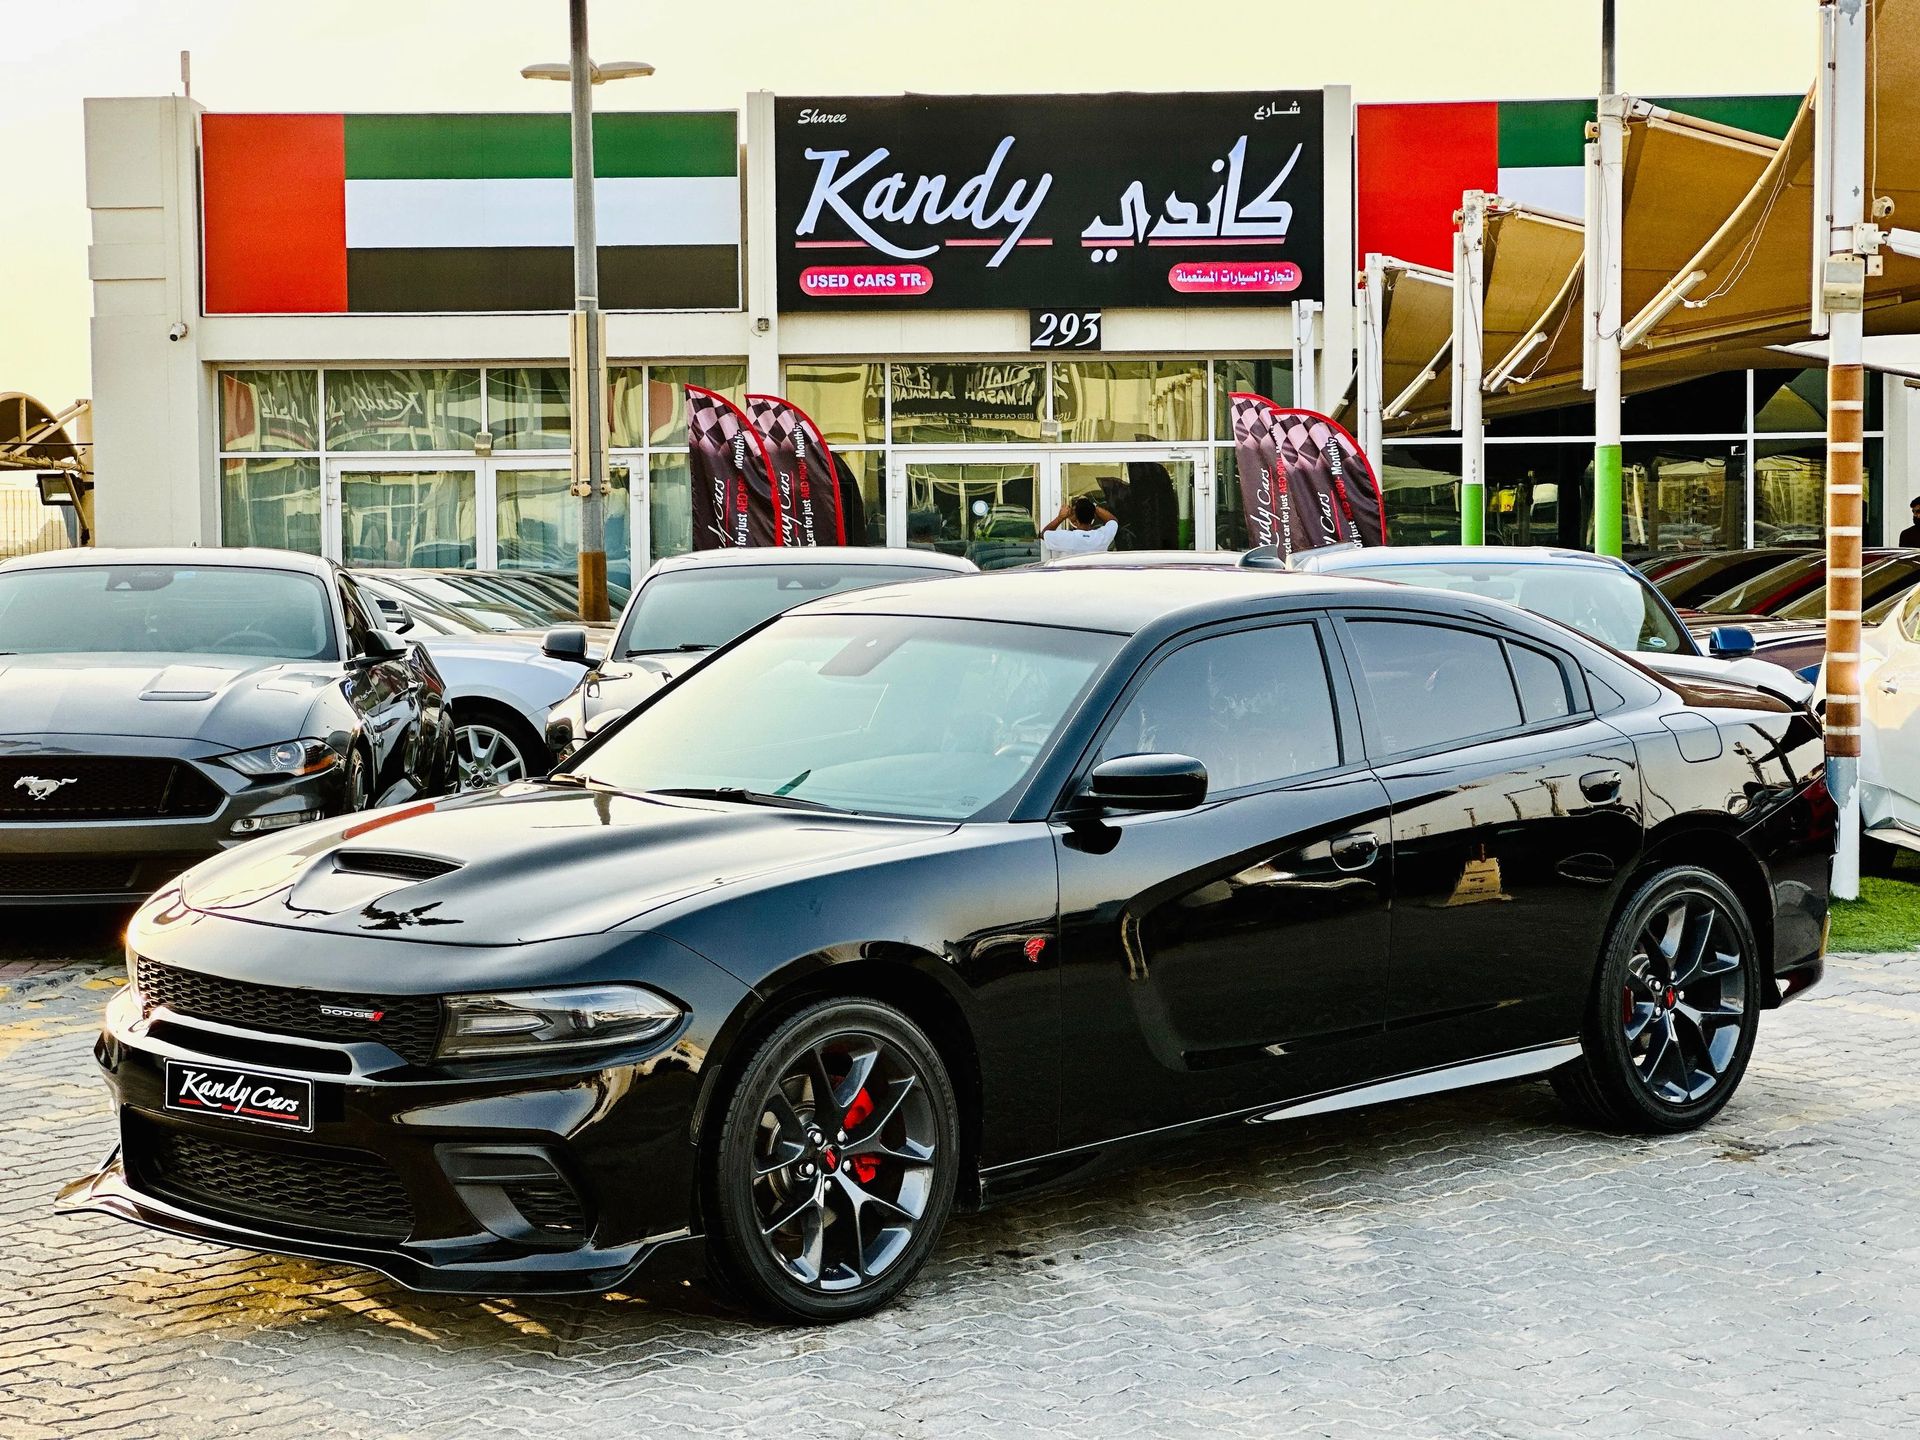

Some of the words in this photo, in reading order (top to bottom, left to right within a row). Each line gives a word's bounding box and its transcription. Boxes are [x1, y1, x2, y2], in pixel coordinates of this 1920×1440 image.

[797, 108, 848, 125] Sharee
[1253, 100, 1301, 121] شارع
[795, 135, 1053, 268] Kandy
[1080, 135, 1303, 263] كاندي
[806, 274, 850, 288] USED
[853, 273, 896, 287] CARS
[900, 273, 927, 287] TR.
[1175, 268, 1218, 283] المستعملة
[1220, 269, 1262, 286] السيارات
[1263, 269, 1295, 285] لتجارة
[1032, 313, 1101, 347] 293
[792, 422, 806, 457] Monthly
[1326, 436, 1343, 475] Monthly
[1256, 468, 1271, 506] Cars
[736, 493, 748, 513] AED
[802, 500, 814, 516] just
[1280, 494, 1291, 510] just
[1281, 511, 1290, 523] for
[1317, 491, 1335, 533] Cars
[736, 513, 750, 533] just
[803, 517, 814, 530] for
[1283, 524, 1291, 537] car
[1349, 520, 1362, 539] just
[735, 533, 747, 546] for
[806, 529, 816, 544] car
[1353, 539, 1363, 549] or
[1283, 537, 1292, 557] scle
[320, 1007, 375, 1019] DODGE
[178, 1069, 251, 1114] Kandy
[250, 1086, 300, 1113] Cars
